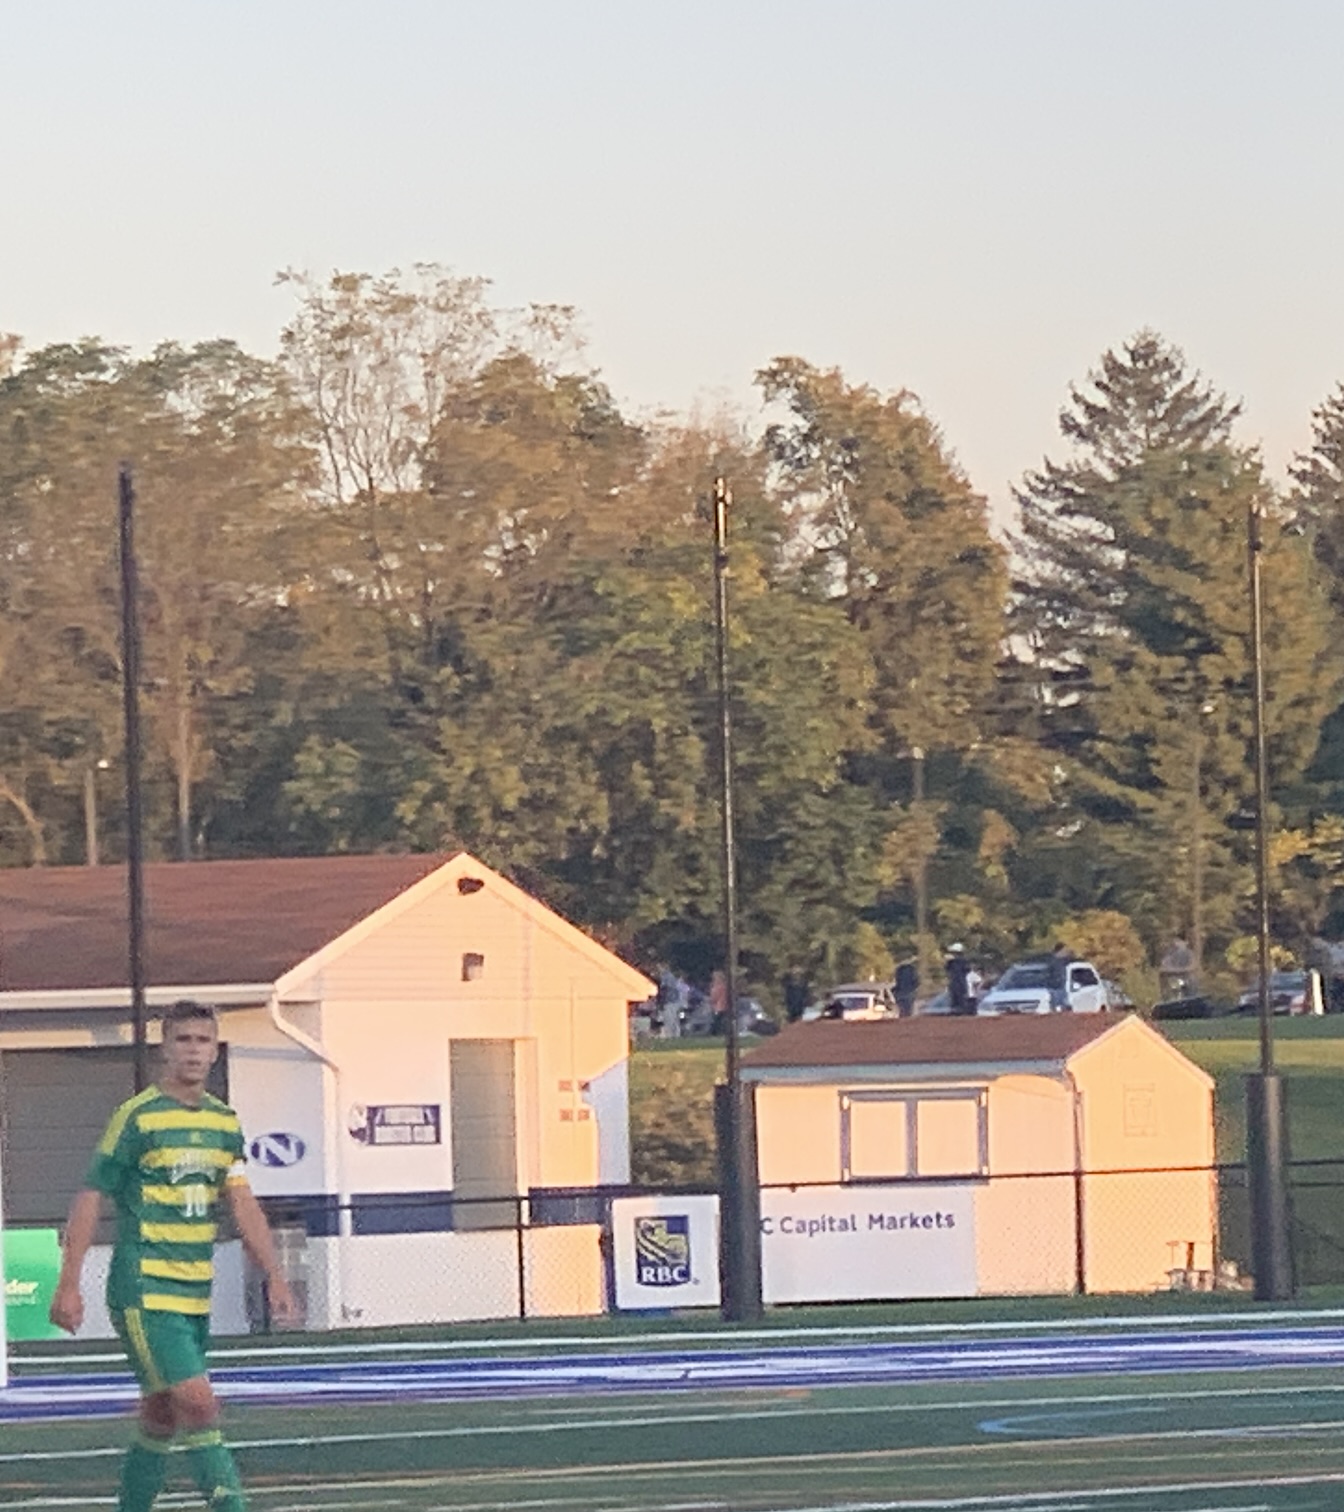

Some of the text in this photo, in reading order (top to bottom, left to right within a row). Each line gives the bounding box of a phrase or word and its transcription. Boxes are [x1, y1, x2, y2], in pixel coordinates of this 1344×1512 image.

[780, 1214, 858, 1238] Capital
[868, 1211, 956, 1231] Markets
[641, 1265, 688, 1283] RBC
